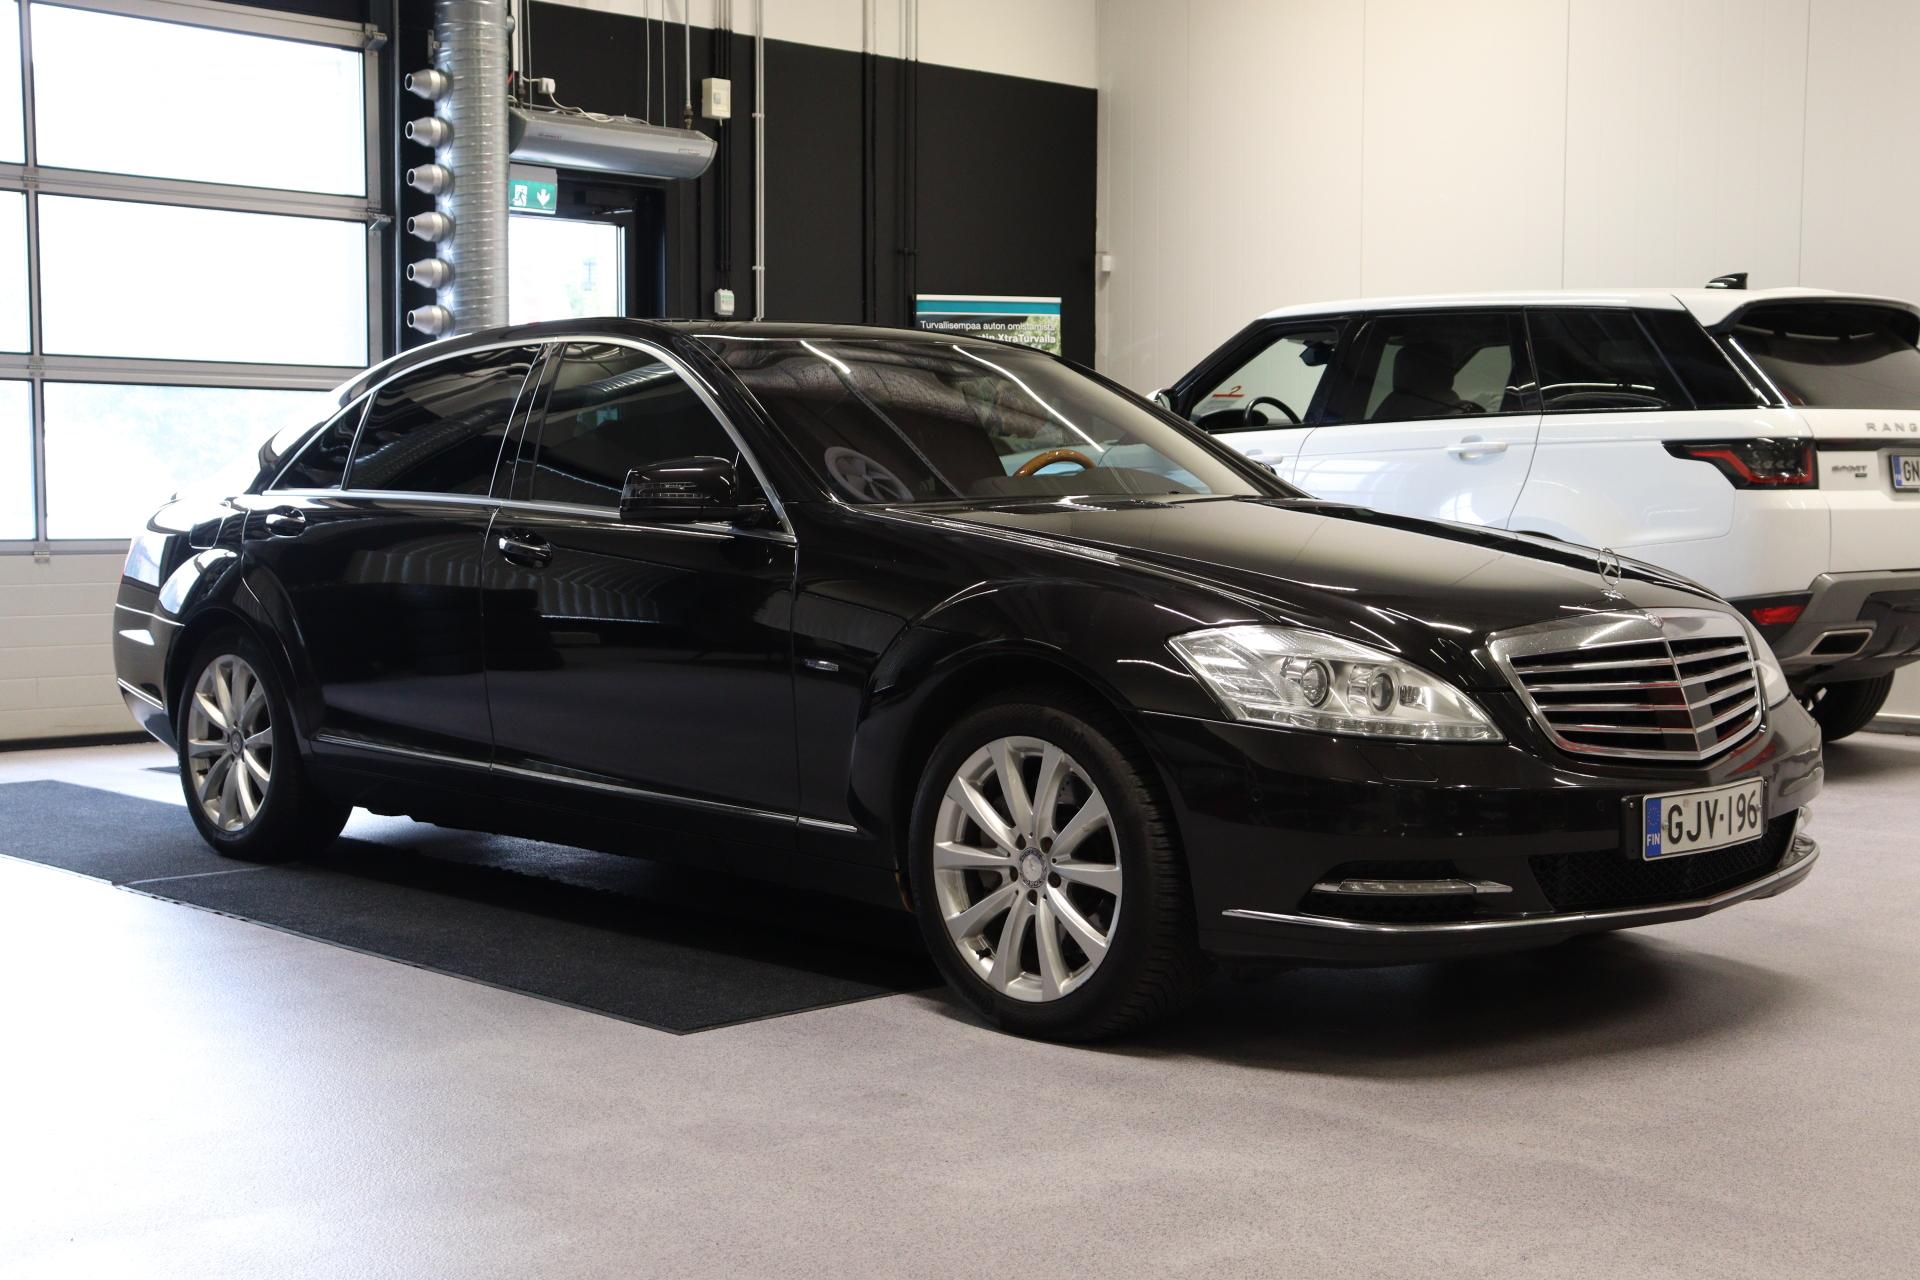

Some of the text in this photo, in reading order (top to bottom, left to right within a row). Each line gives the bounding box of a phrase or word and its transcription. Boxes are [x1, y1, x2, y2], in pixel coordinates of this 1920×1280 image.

[920, 320, 1056, 331] Turvallisempaa auton omistamista
[1866, 423, 1918, 432] RANG
[1668, 790, 1758, 844] GJV-196
[1646, 833, 1660, 847] FIN
